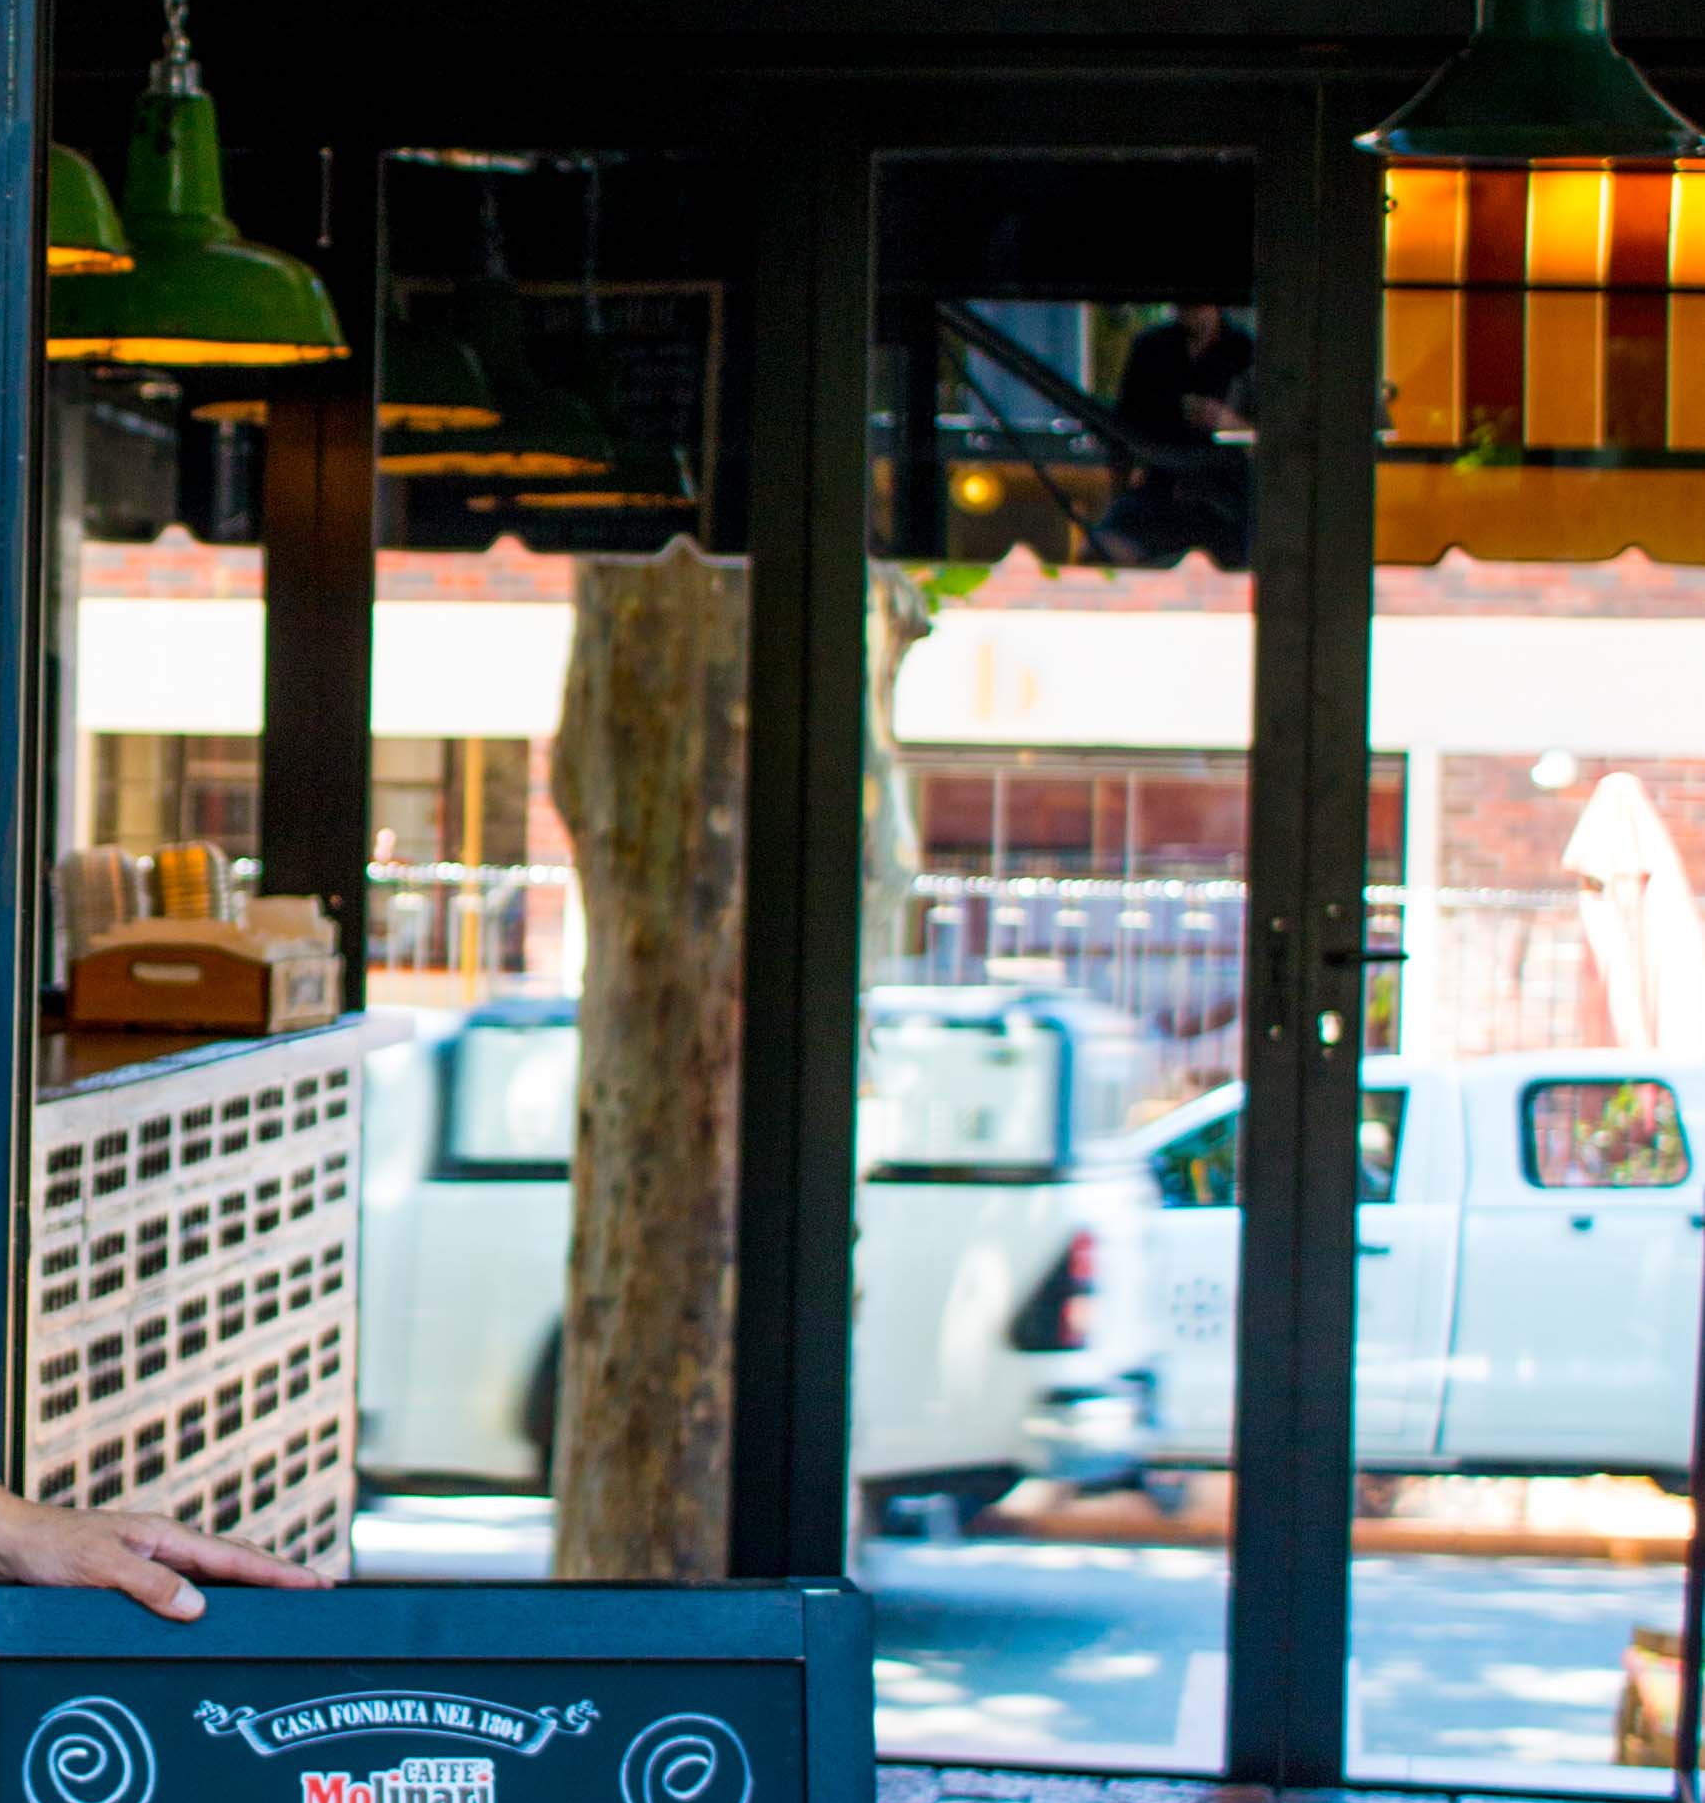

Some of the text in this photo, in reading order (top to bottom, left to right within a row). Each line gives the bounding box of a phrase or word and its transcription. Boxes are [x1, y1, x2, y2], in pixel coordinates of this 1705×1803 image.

[272, 1699, 524, 1742] CASA FONDATA NEL 1804
